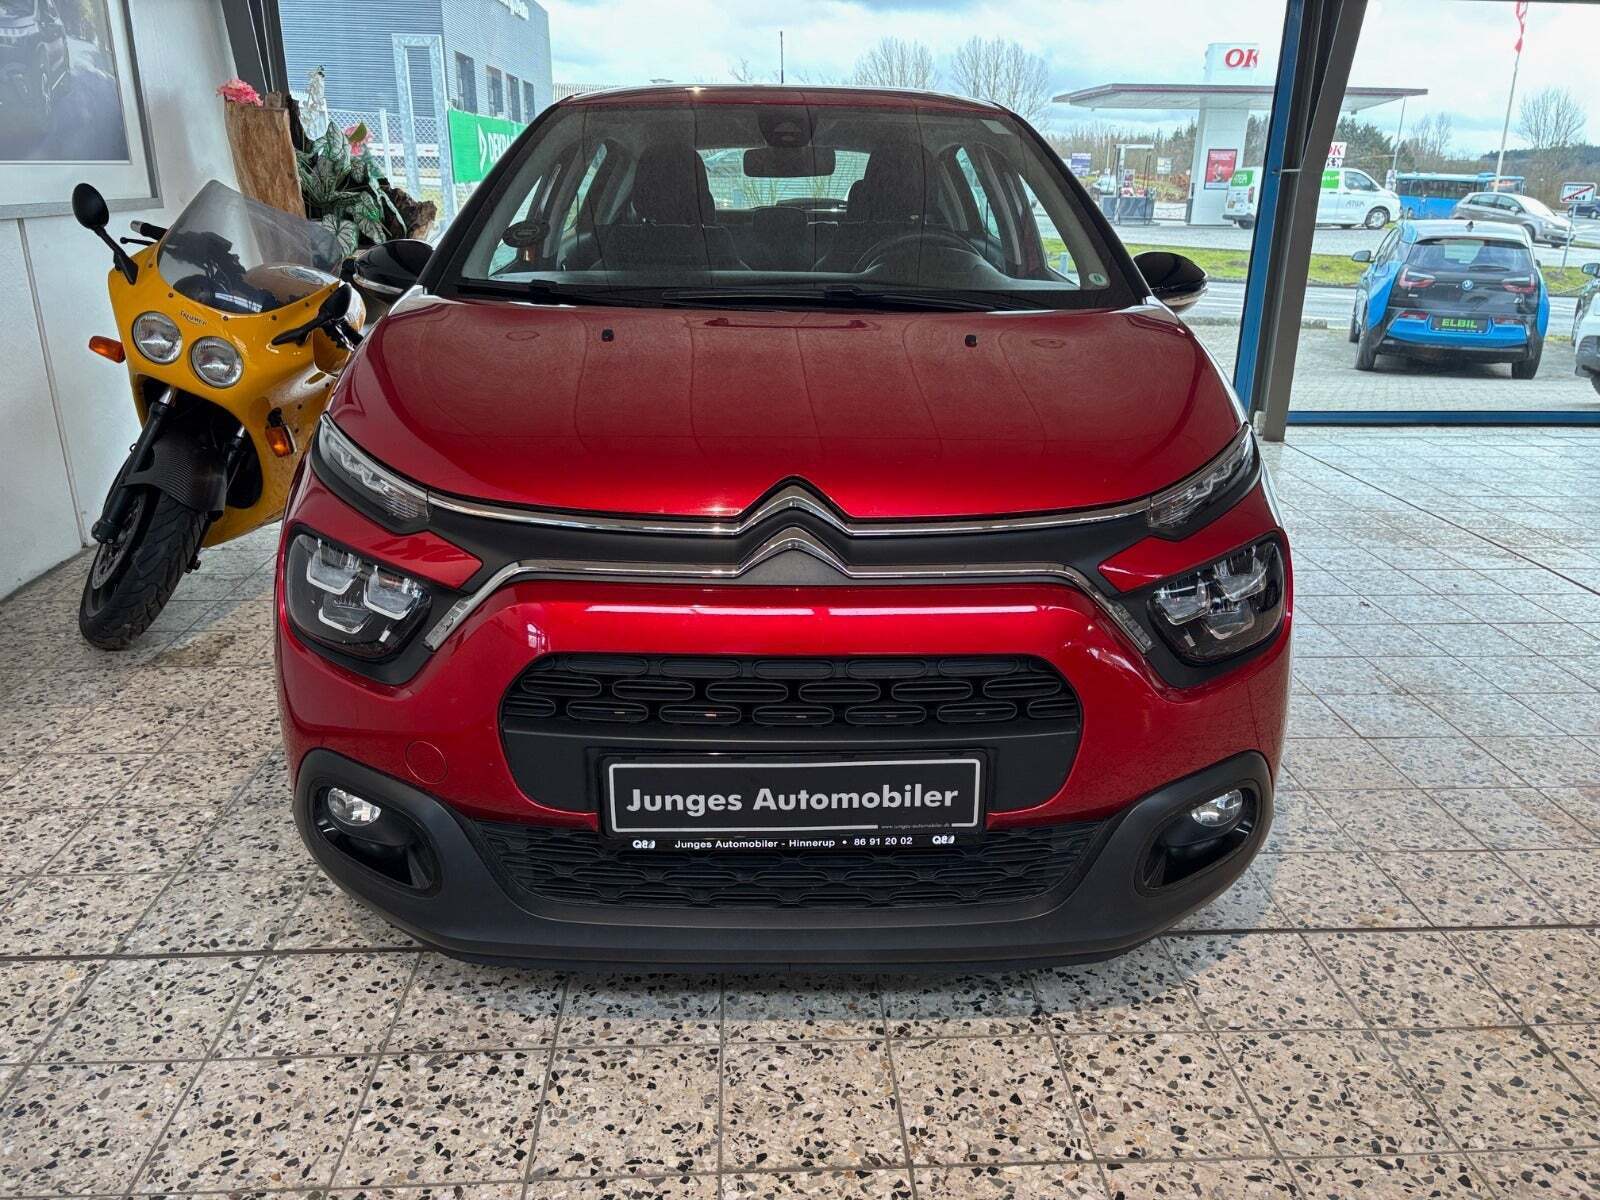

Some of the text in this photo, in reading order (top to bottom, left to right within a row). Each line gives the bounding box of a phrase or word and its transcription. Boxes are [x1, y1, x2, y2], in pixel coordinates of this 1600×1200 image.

[1225, 48, 1258, 68] OK
[1441, 318, 1478, 329] ELBIL
[626, 783, 959, 817] Junges Automobiler
[674, 840, 712, 850] Junges
[715, 839, 779, 849] Automobiler
[788, 838, 836, 848] Hinnerup
[854, 837, 867, 846] 86
[869, 837, 881, 846] 91
[885, 837, 898, 845] 20
[900, 836, 913, 845] 02
